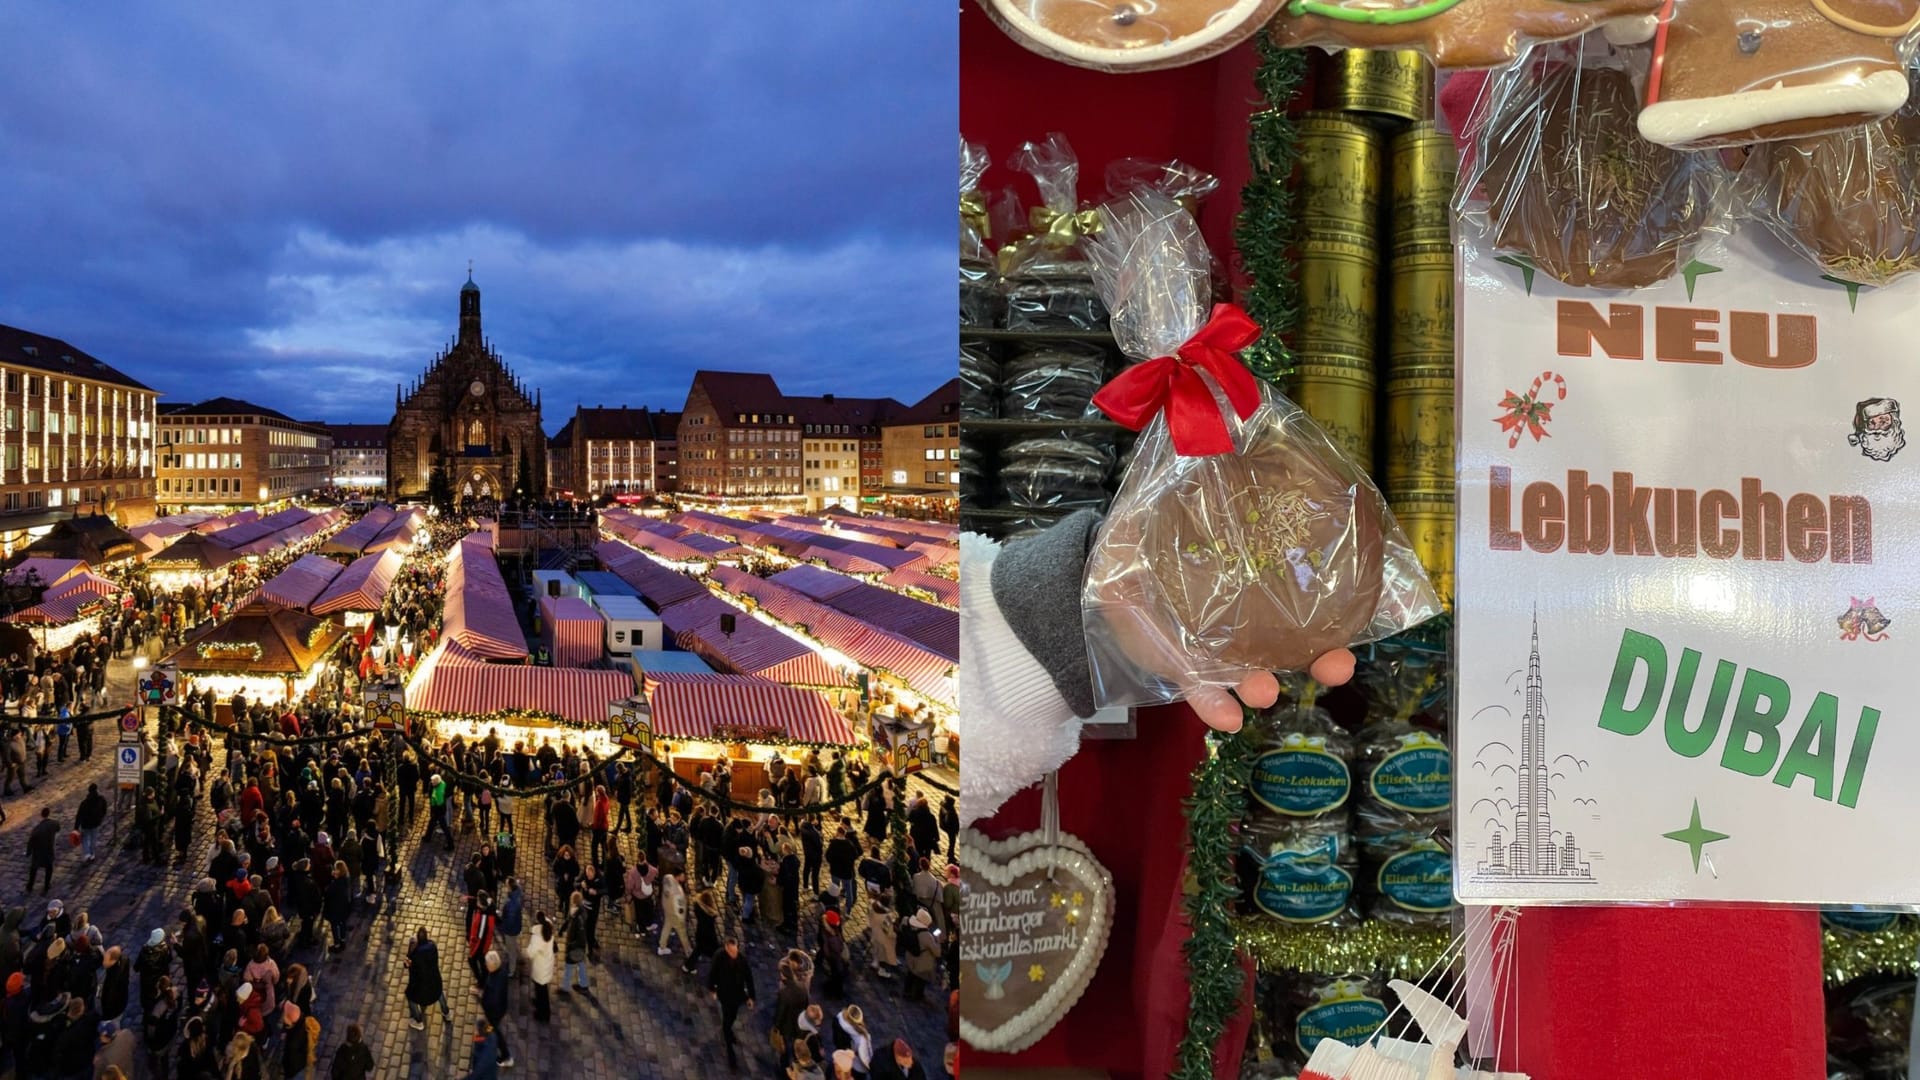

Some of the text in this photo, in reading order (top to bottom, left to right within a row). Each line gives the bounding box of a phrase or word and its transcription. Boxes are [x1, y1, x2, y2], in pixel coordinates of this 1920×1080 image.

[1557, 300, 1817, 369] NEU
[1489, 465, 1873, 565] Lebkuchen
[1597, 628, 1881, 809] DUBAI
[1004, 888, 1037, 908] vom
